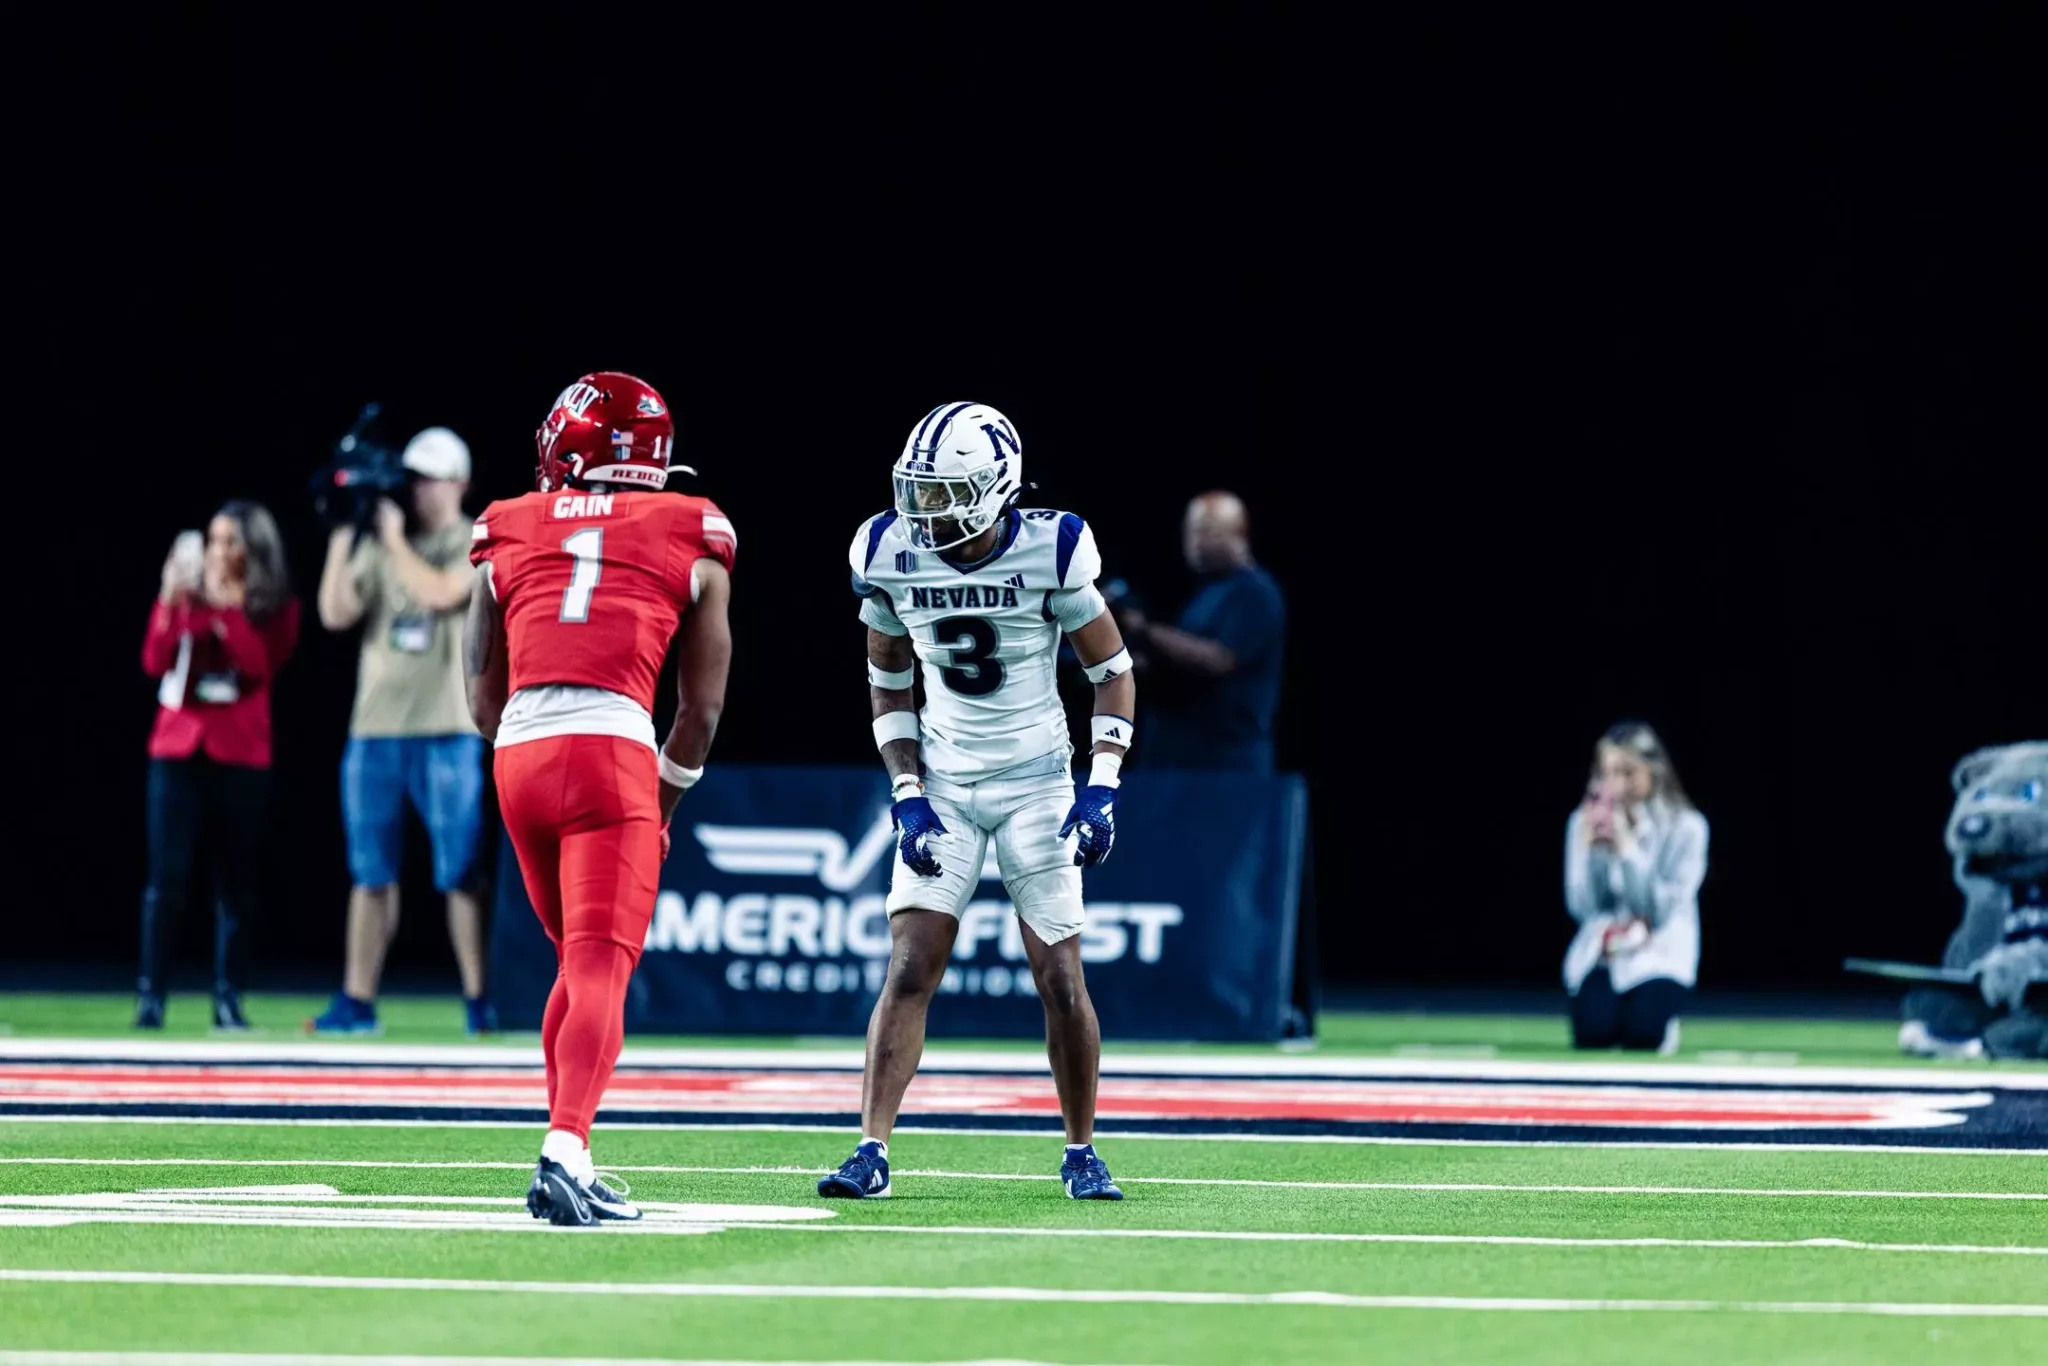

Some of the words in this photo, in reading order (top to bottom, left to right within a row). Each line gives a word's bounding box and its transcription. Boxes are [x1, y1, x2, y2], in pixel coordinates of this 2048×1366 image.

[652, 434, 662, 460] 1
[980, 419, 1020, 461] N
[611, 468, 666, 485] REBELS
[553, 494, 615, 519] CAIN
[558, 527, 604, 623] 1
[909, 585, 1019, 609] NEVADA
[933, 615, 1006, 697] 3
[642, 889, 894, 958] MERIC
[951, 899, 1184, 963] FIST
